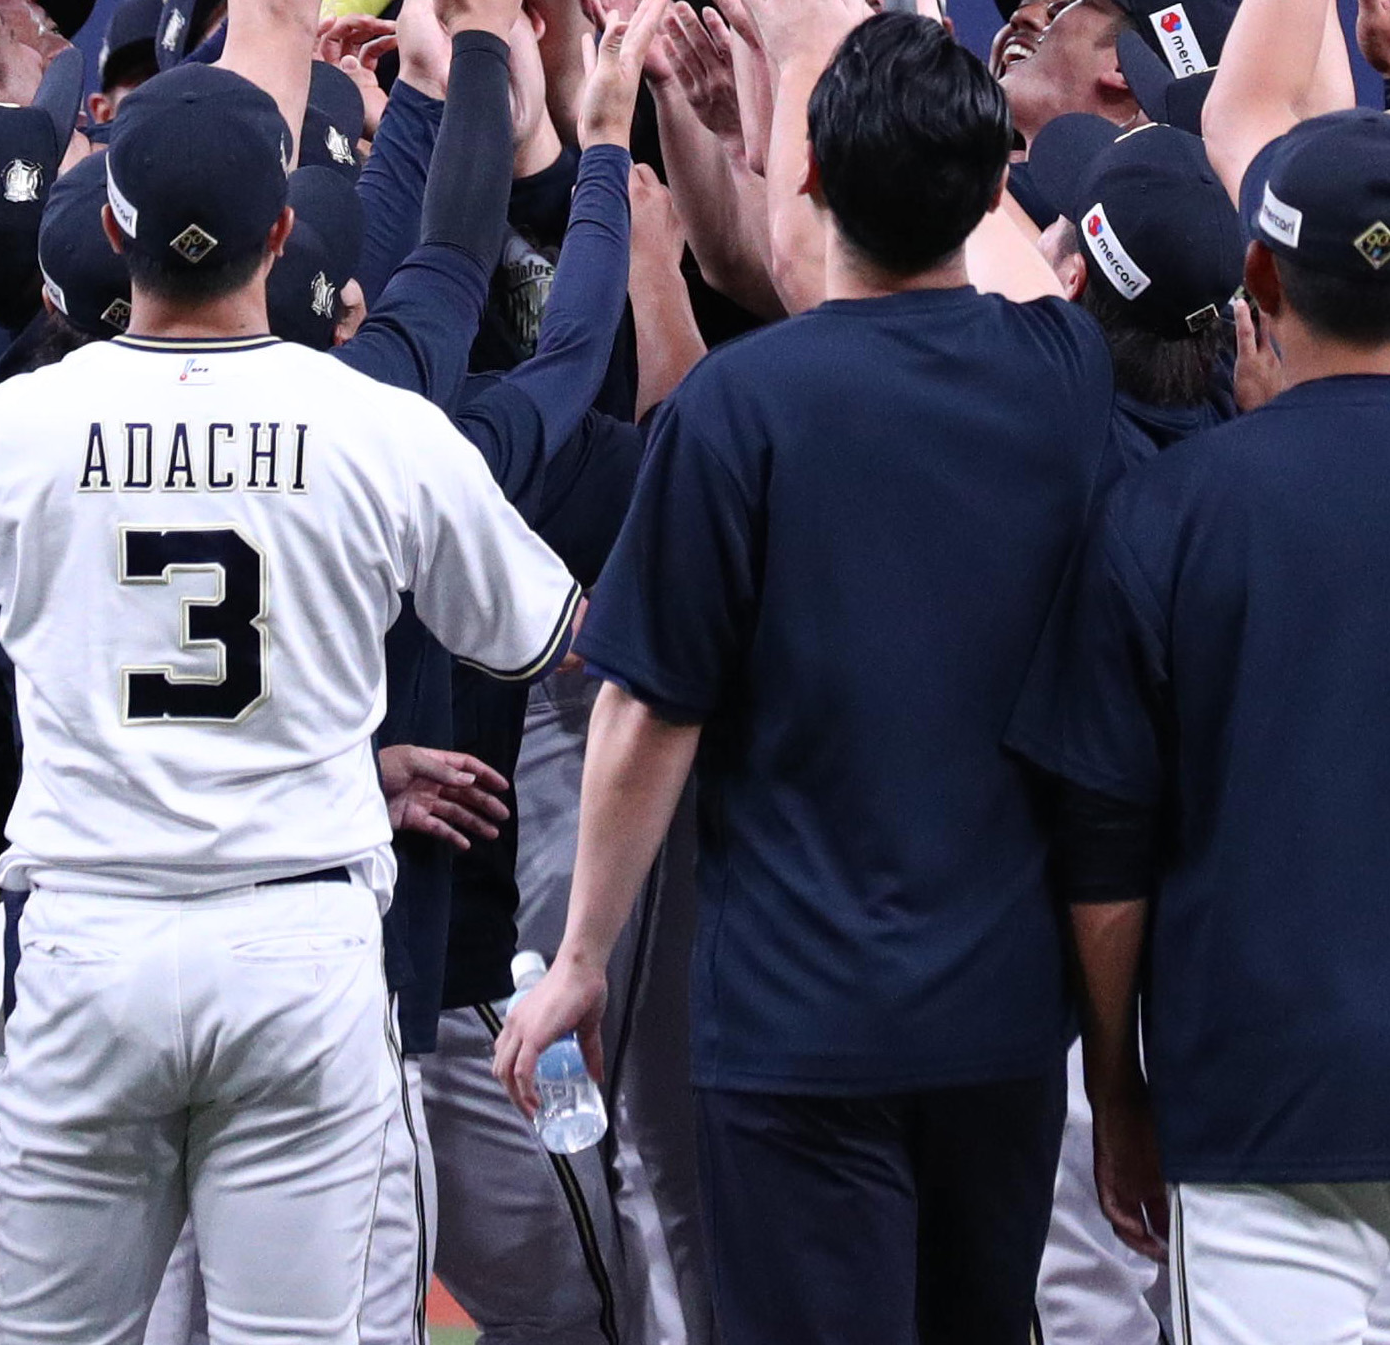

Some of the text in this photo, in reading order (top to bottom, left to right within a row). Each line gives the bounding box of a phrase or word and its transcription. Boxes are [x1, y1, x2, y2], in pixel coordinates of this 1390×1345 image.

[1171, 35, 1195, 74] merc
[1097, 237, 1142, 292] mercari
[78, 421, 309, 493] ADACHI
[118, 522, 272, 726] 3
